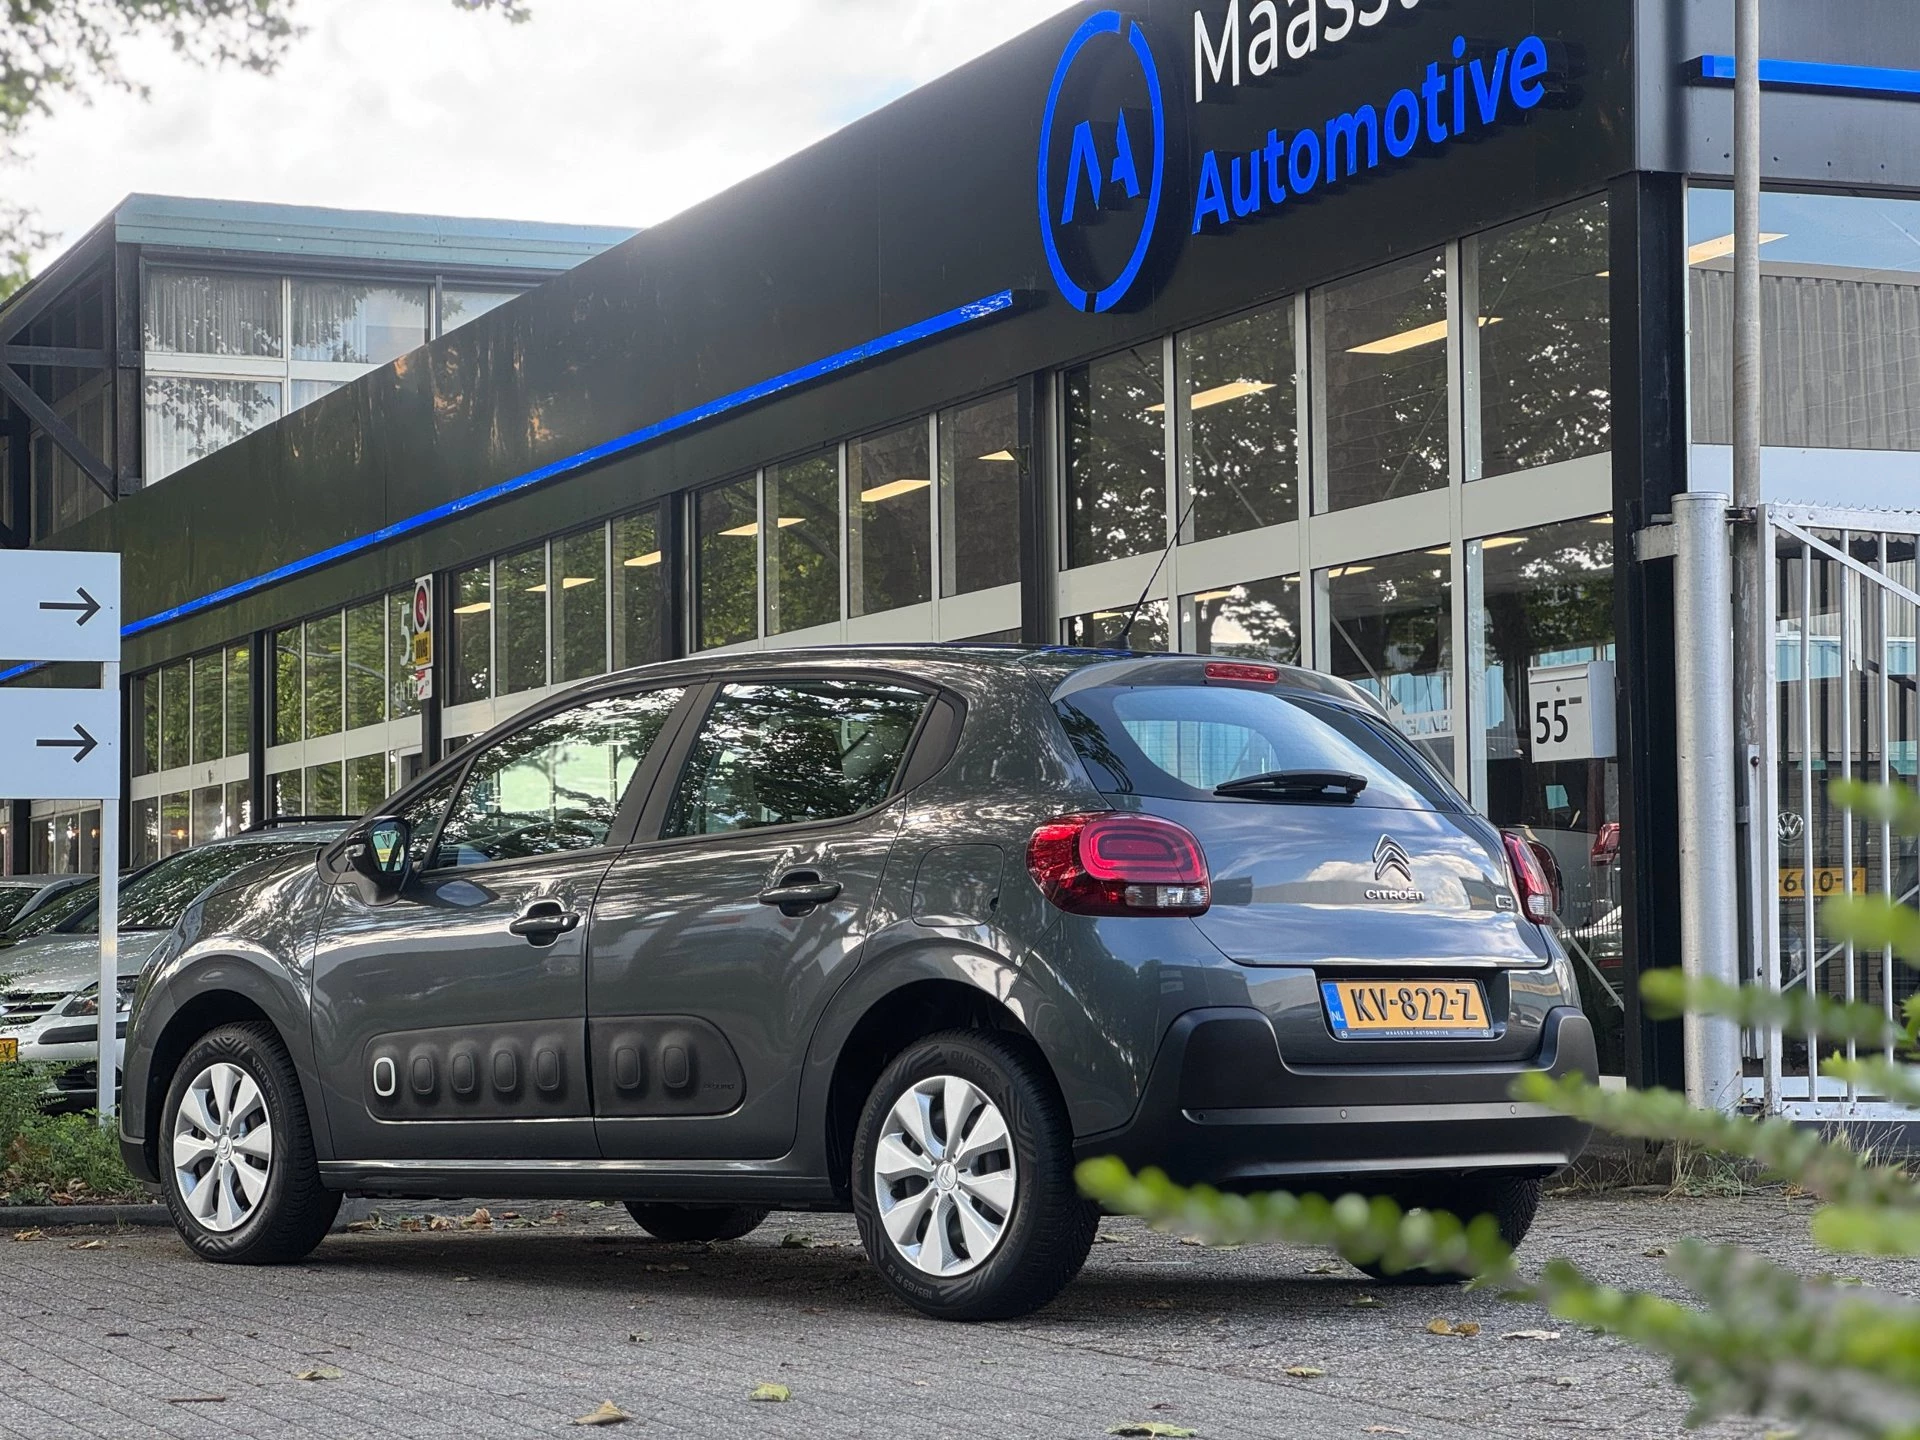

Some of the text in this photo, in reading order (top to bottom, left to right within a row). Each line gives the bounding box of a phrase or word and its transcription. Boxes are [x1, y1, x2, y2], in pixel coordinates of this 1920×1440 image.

[1194, 0, 1419, 103] Maas
[1192, 35, 1548, 235] Automotive
[1536, 699, 1568, 744] 55
[1330, 1010, 1345, 1022] NL
[1349, 987, 1479, 1022] KV-822-Z
